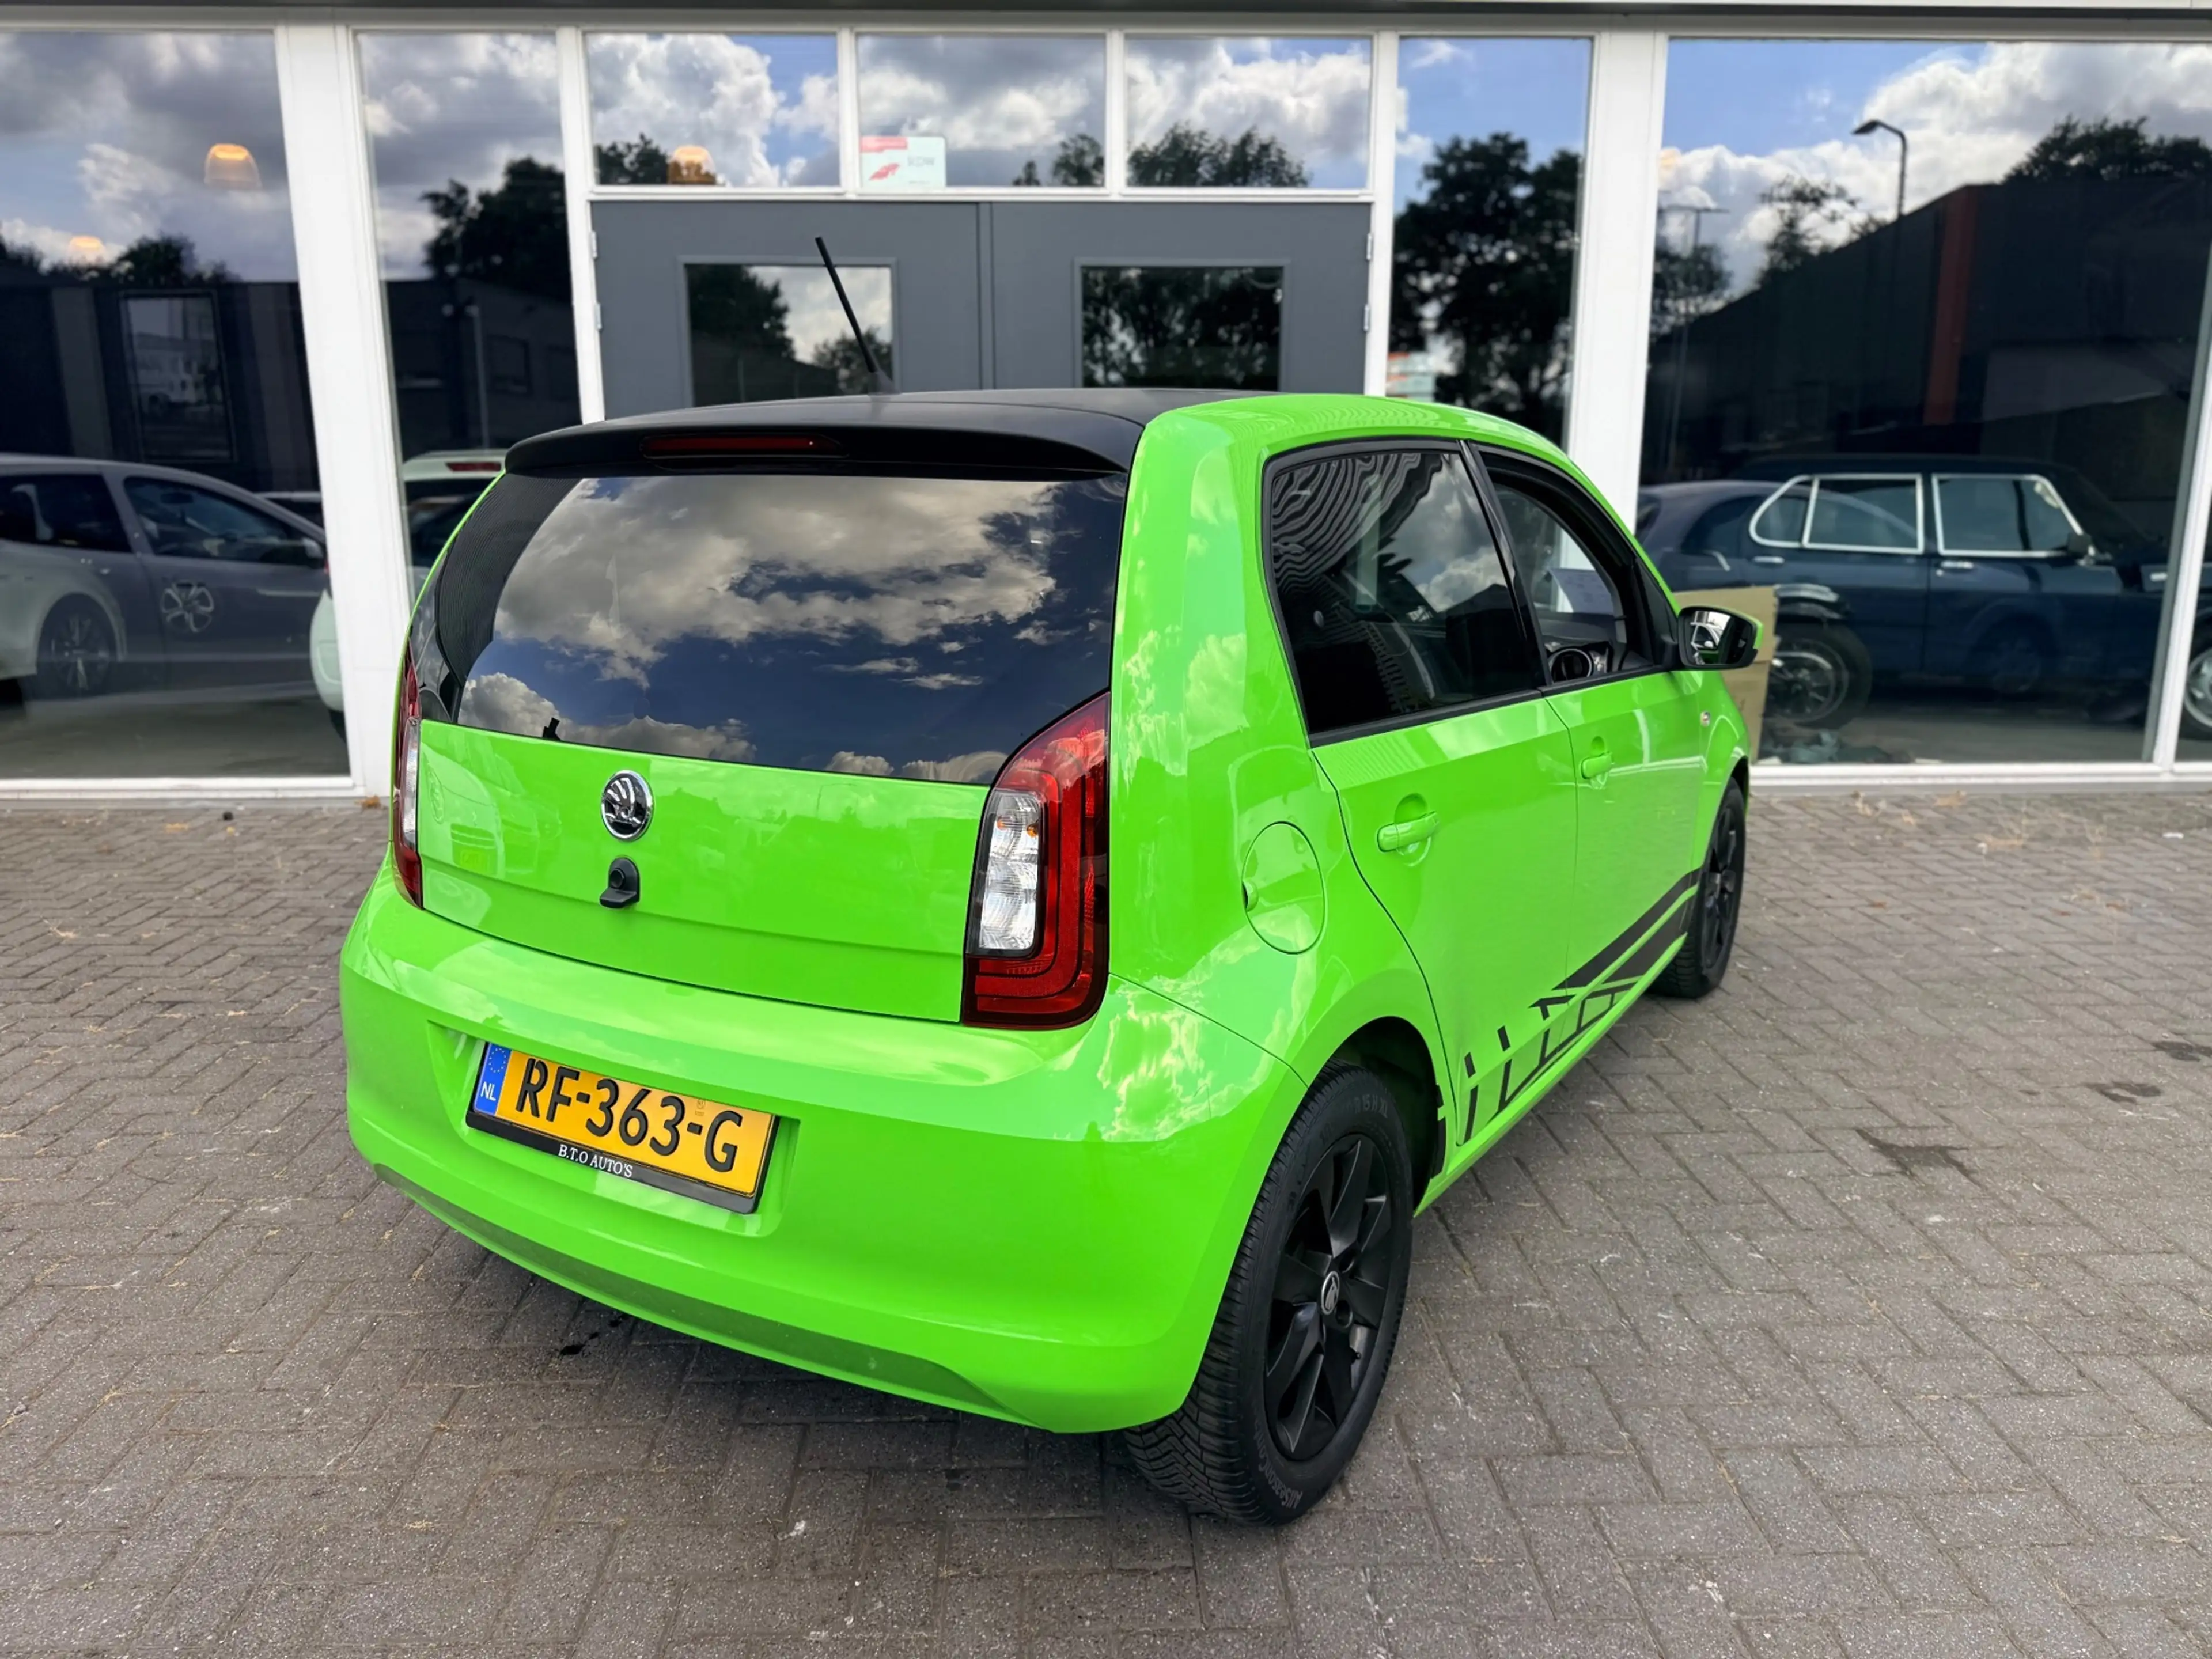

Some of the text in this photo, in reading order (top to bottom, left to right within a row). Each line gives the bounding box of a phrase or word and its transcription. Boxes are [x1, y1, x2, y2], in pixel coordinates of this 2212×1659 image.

[480, 1081, 496, 1101] NL
[515, 1058, 743, 1172] RF-363-G
[558, 1144, 633, 1177] B.T.O AUTO'S
